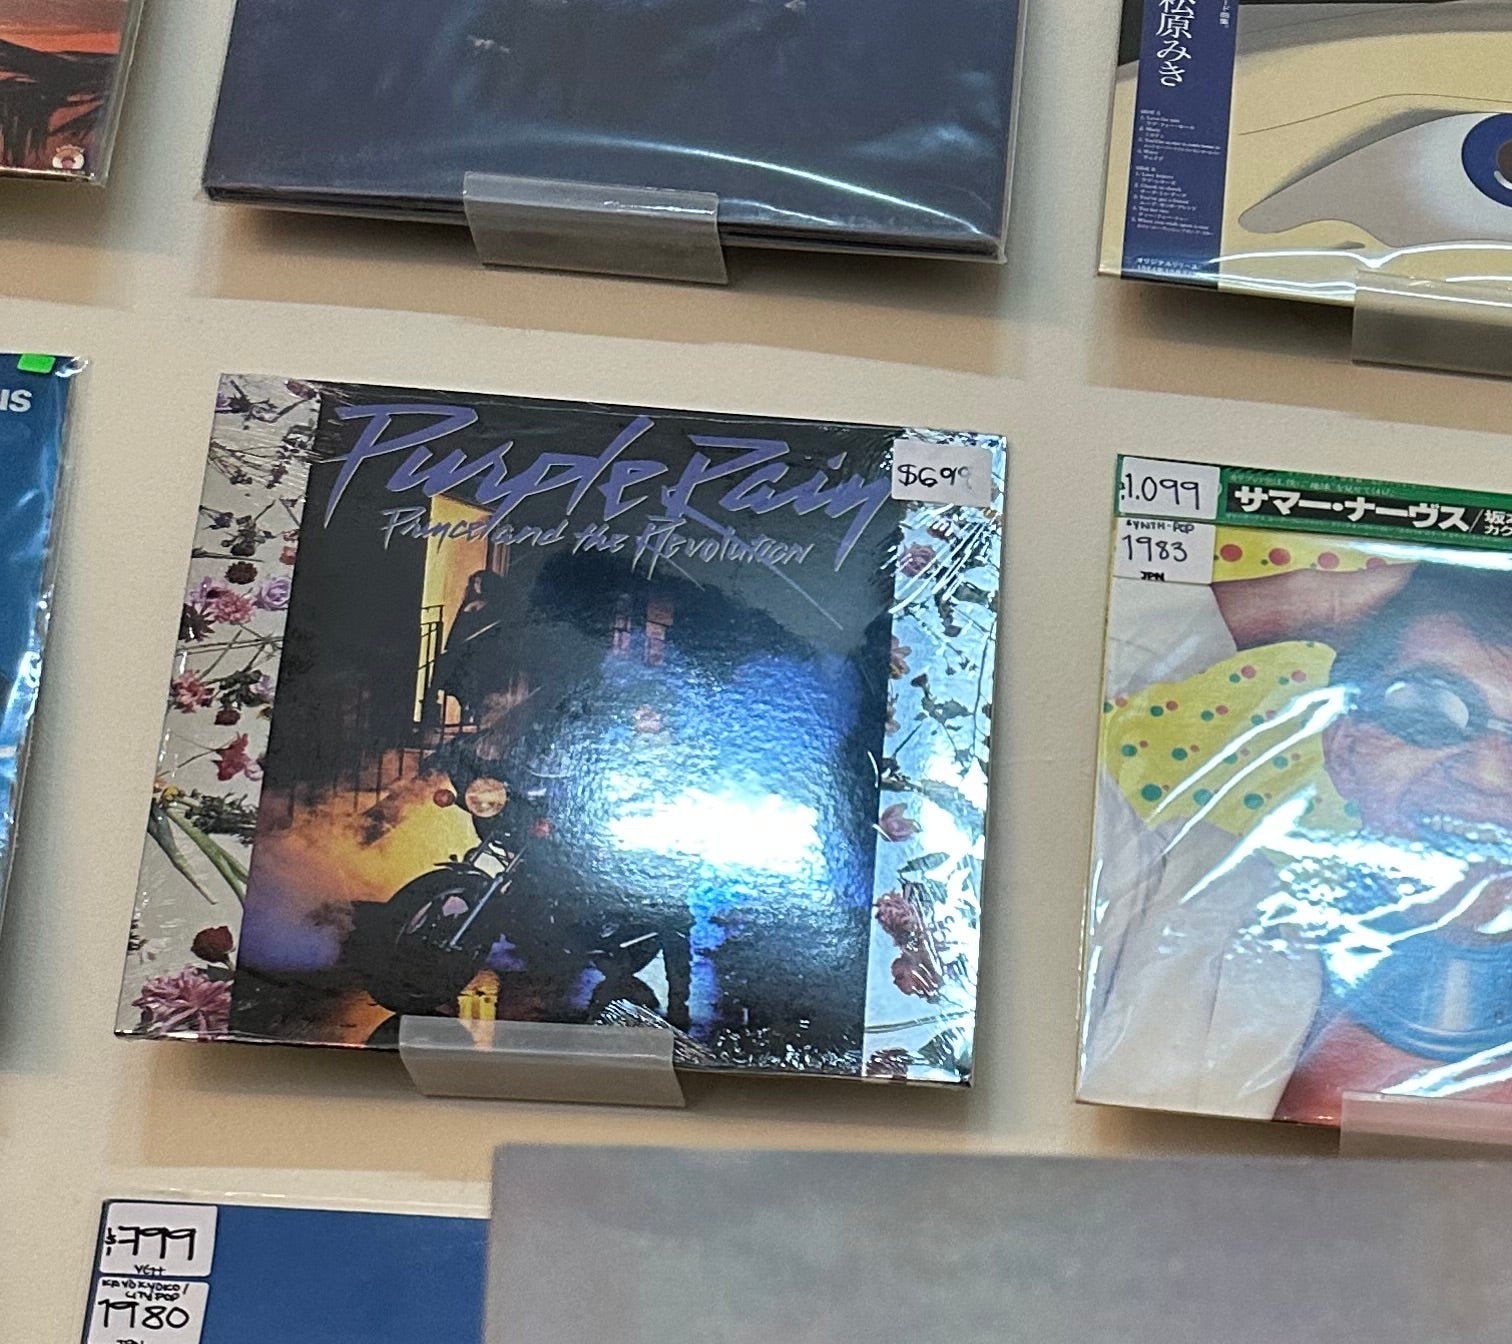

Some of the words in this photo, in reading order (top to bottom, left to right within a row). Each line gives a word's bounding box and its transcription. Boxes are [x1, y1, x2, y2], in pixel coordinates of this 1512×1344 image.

[323, 403, 670, 542] Purple
[661, 433, 893, 582] Rain
[381, 505, 487, 551] Prince
[492, 519, 570, 546] and
[572, 520, 632, 556] the
[634, 514, 816, 581] Revolution
[1121, 534, 1188, 563] 1983
[1140, 570, 1166, 582] JPN
[104, 1226, 197, 1261] $799
[97, 1299, 190, 1330] 1980
